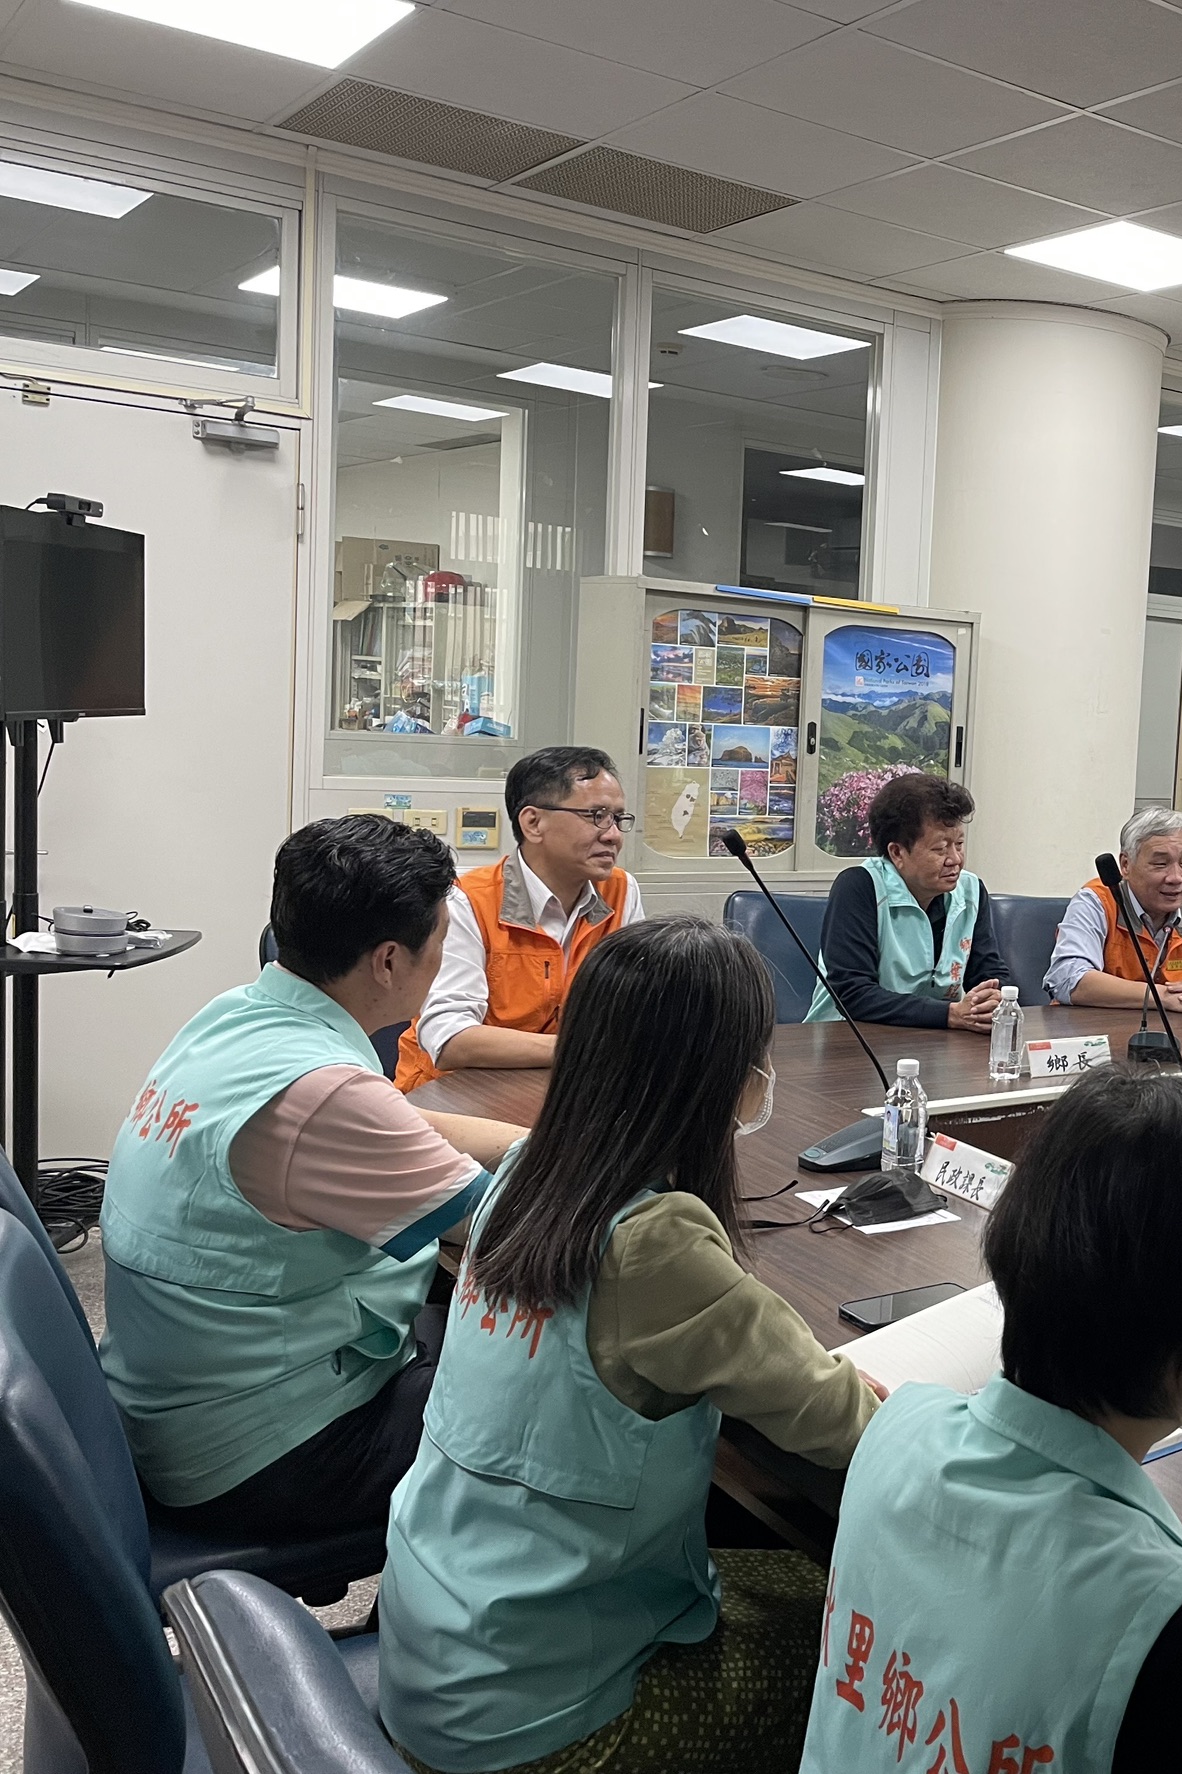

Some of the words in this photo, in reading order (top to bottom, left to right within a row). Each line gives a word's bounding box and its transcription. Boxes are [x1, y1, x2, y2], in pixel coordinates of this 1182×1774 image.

[855, 649, 930, 678] 國家公園
[1046, 1051, 1094, 1073] 鄉長
[935, 1160, 987, 1201] 民政課長
[820, 1566, 1055, 1774] 里鄉公
